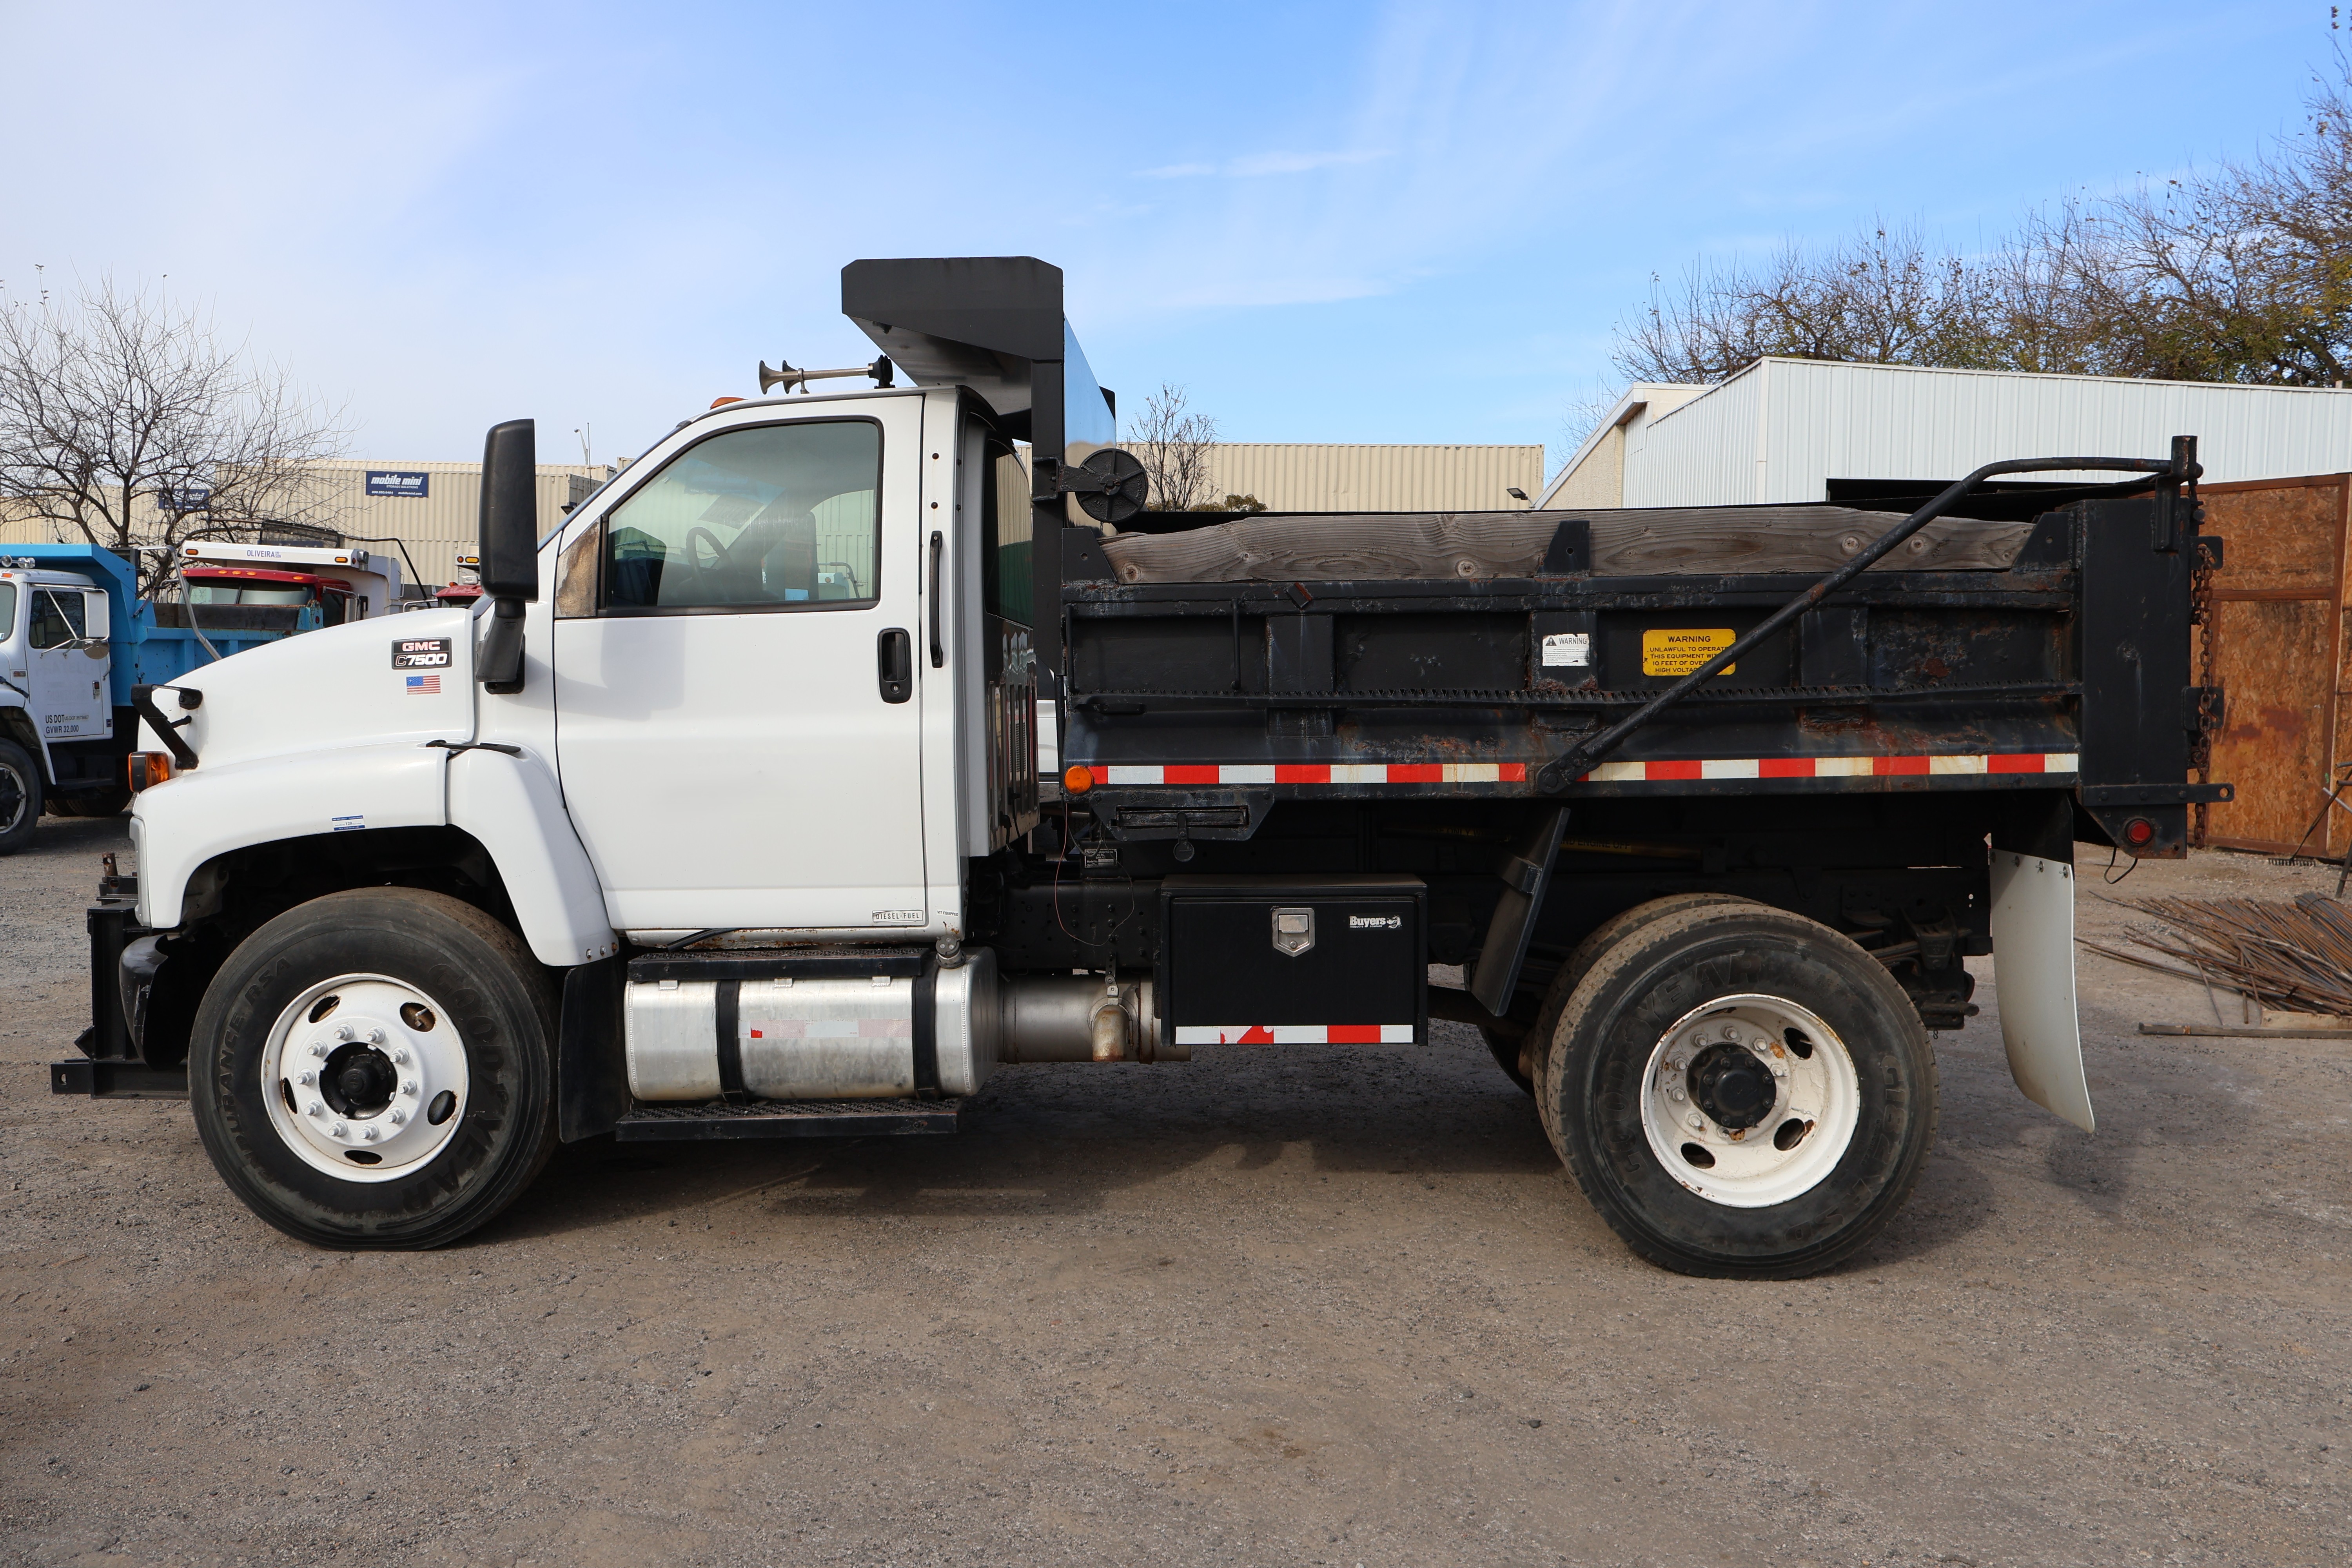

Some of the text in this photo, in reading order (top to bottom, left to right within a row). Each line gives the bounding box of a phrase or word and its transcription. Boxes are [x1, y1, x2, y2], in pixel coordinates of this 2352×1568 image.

[371, 474, 423, 485] mobile mini
[402, 641, 440, 652] GMC
[396, 653, 448, 666] C7500
[45, 714, 64, 724] US DOT
[46, 725, 79, 734] GVWR 32,000
[1578, 837, 1610, 848] ENGINE
[1613, 840, 1630, 850] OFF
[1349, 916, 1386, 928] Buyers
[243, 956, 293, 1007] RSA
[1597, 950, 1762, 1185] GOODYEAR
[402, 963, 506, 1216] GOODYEAR
[1782, 1055, 1911, 1247] G182 RSD
